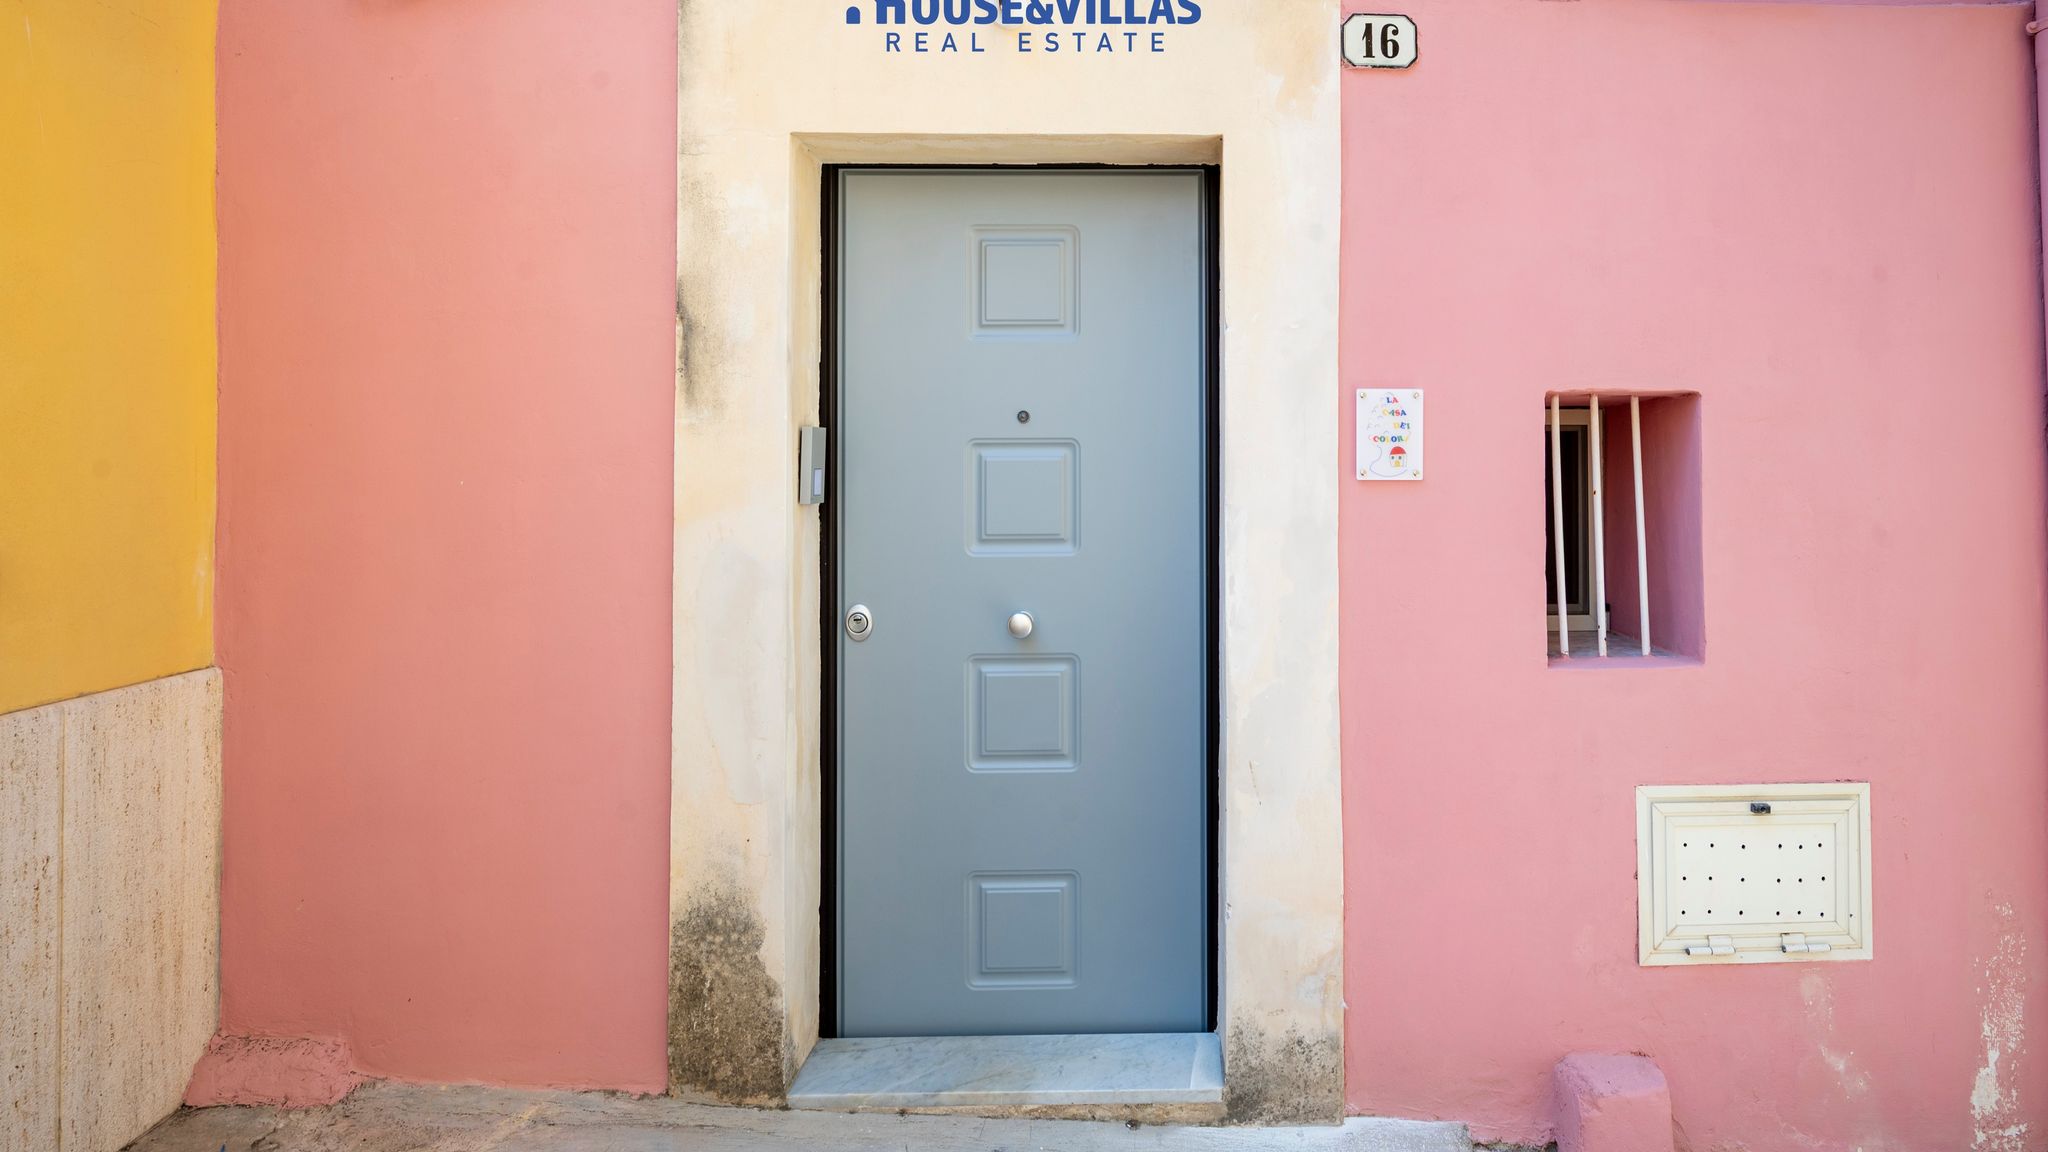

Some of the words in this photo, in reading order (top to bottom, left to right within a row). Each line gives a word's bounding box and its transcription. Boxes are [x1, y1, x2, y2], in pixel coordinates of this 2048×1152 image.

[1361, 22, 1400, 59] 16
[1386, 396, 1399, 404] LA
[1382, 409, 1407, 417] CASA
